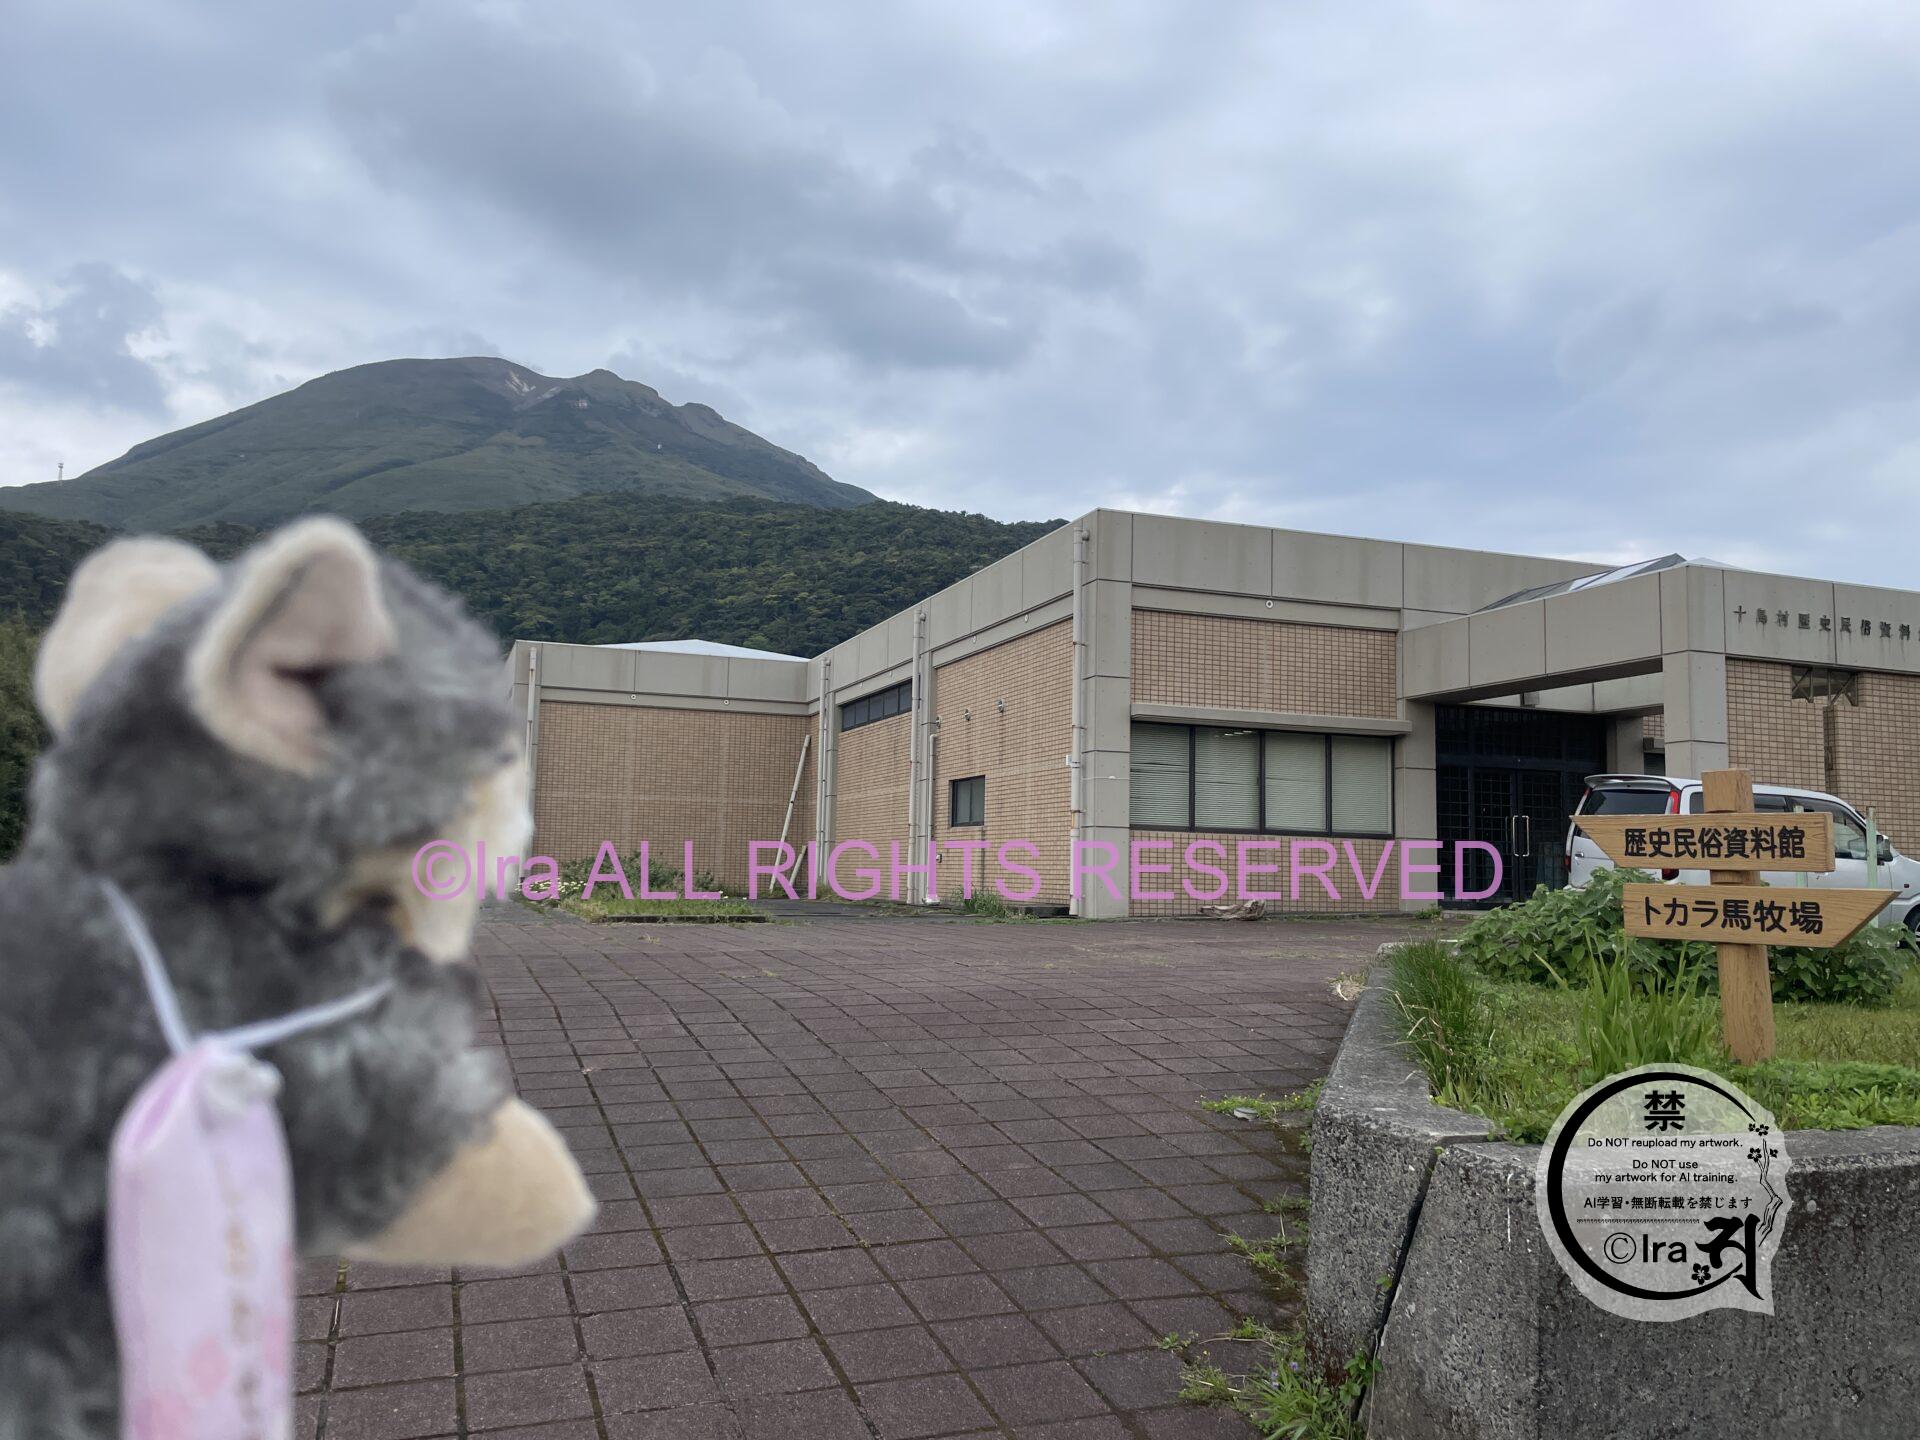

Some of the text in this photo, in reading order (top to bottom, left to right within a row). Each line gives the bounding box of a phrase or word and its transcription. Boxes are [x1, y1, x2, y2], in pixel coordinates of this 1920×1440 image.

[1733, 605, 1920, 641] 十島村歴史民俗資料
[1624, 826, 1805, 859] 歴史民俗資料館
[1644, 896, 1823, 935] トカラ馬牧場
